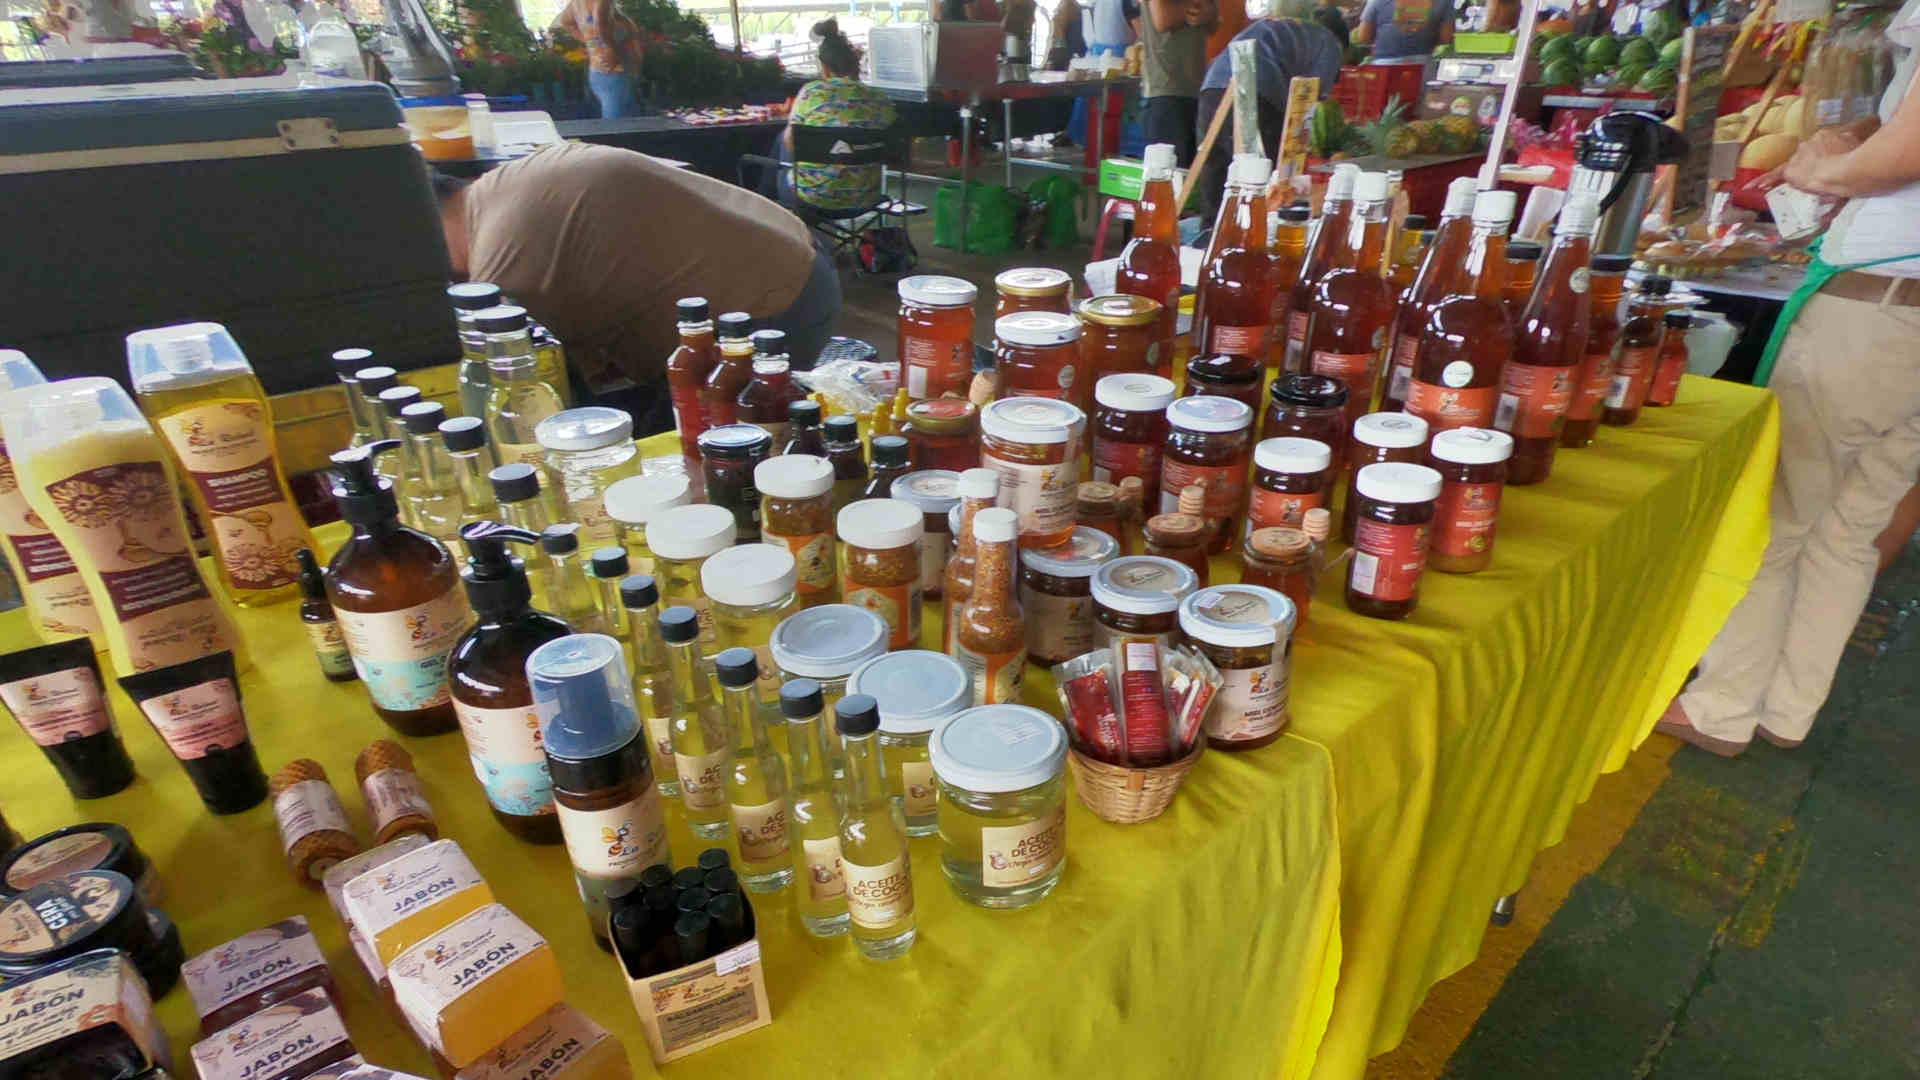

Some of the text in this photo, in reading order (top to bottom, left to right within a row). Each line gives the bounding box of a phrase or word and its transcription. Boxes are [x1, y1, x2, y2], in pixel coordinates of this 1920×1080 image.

[393, 877, 456, 912] JABÓN
[224, 956, 293, 992] JABÓN
[453, 942, 516, 985] JABÓN
[240, 1034, 314, 1078] JABÓN
[520, 1038, 579, 1080] ABÓN
